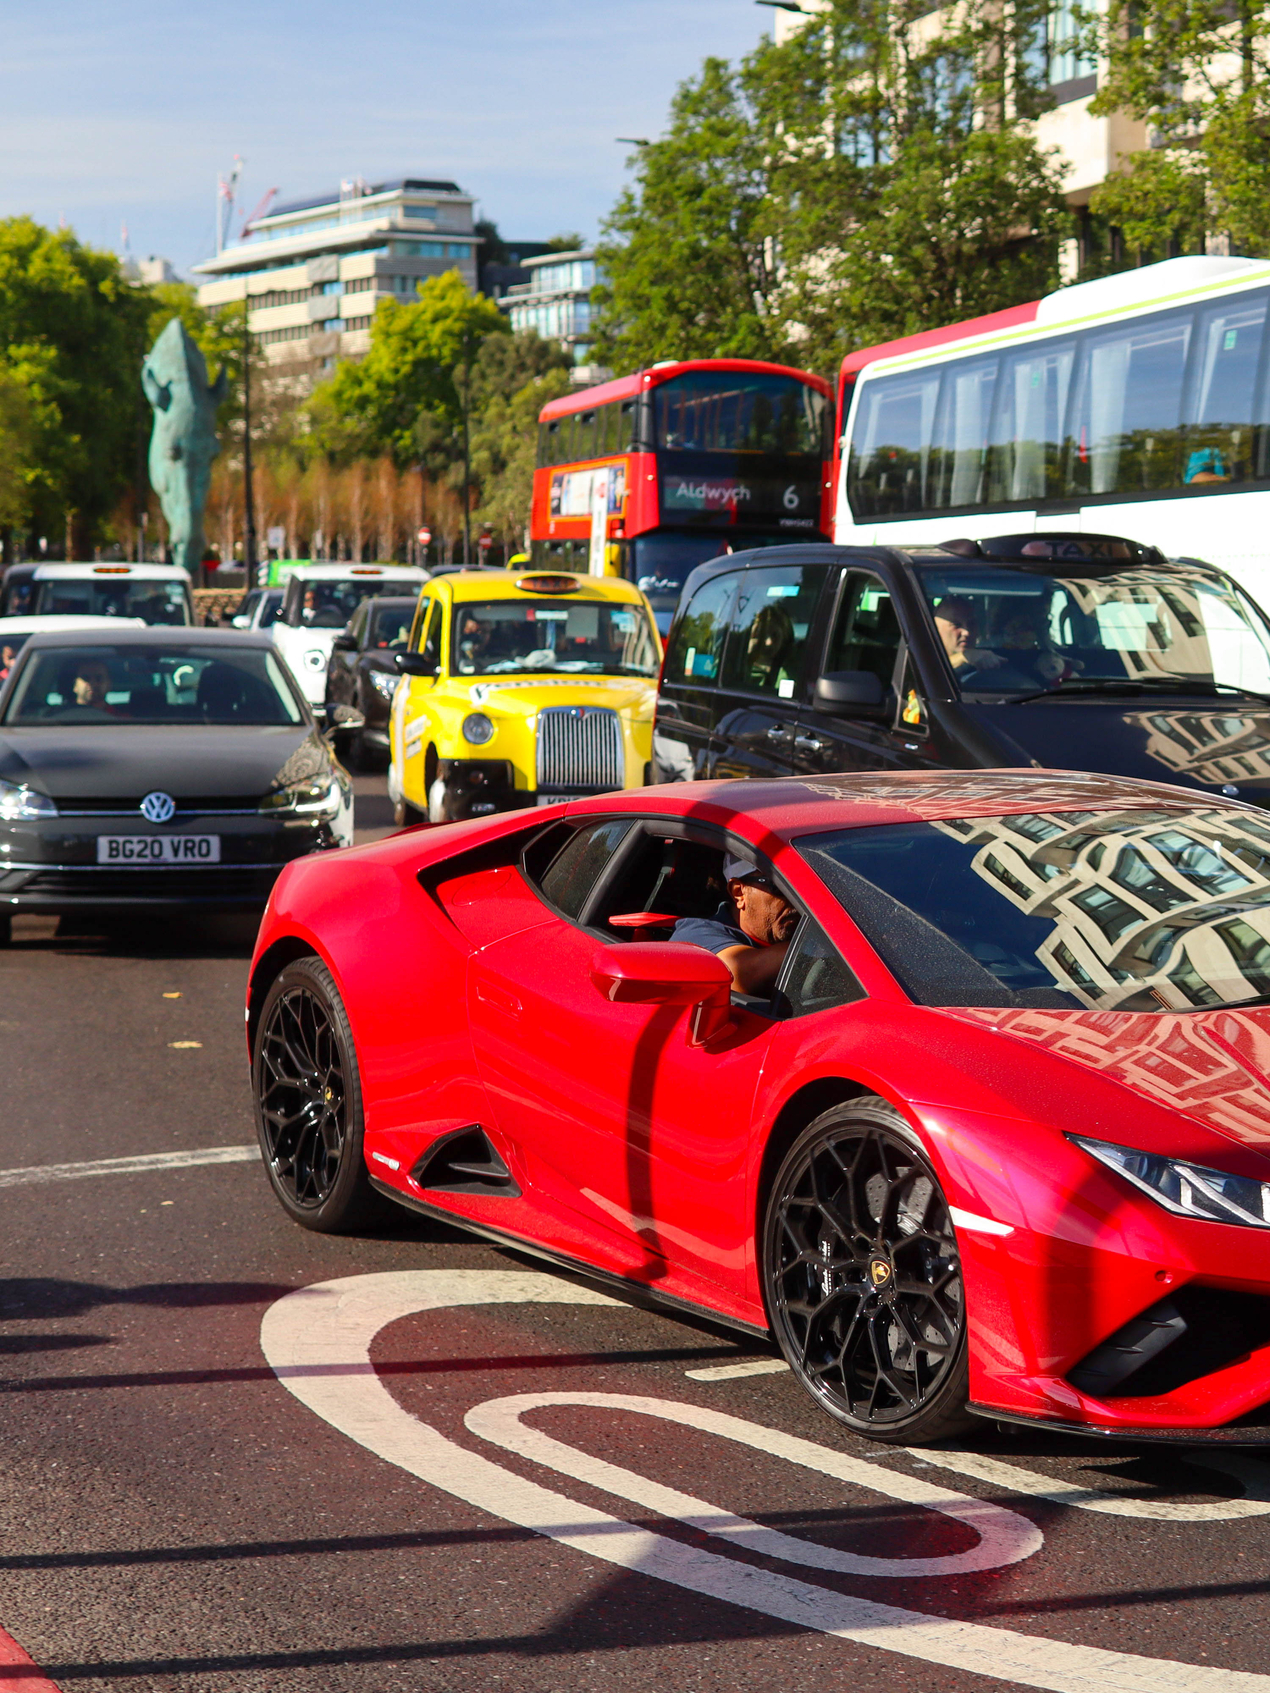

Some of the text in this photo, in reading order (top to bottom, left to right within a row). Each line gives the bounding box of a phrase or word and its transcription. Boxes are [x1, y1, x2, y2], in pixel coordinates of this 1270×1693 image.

[676, 482, 751, 504] Aldwych
[783, 485, 799, 509] 6
[1044, 540, 1113, 557] TAXI
[108, 839, 211, 859] BG20 VRO
